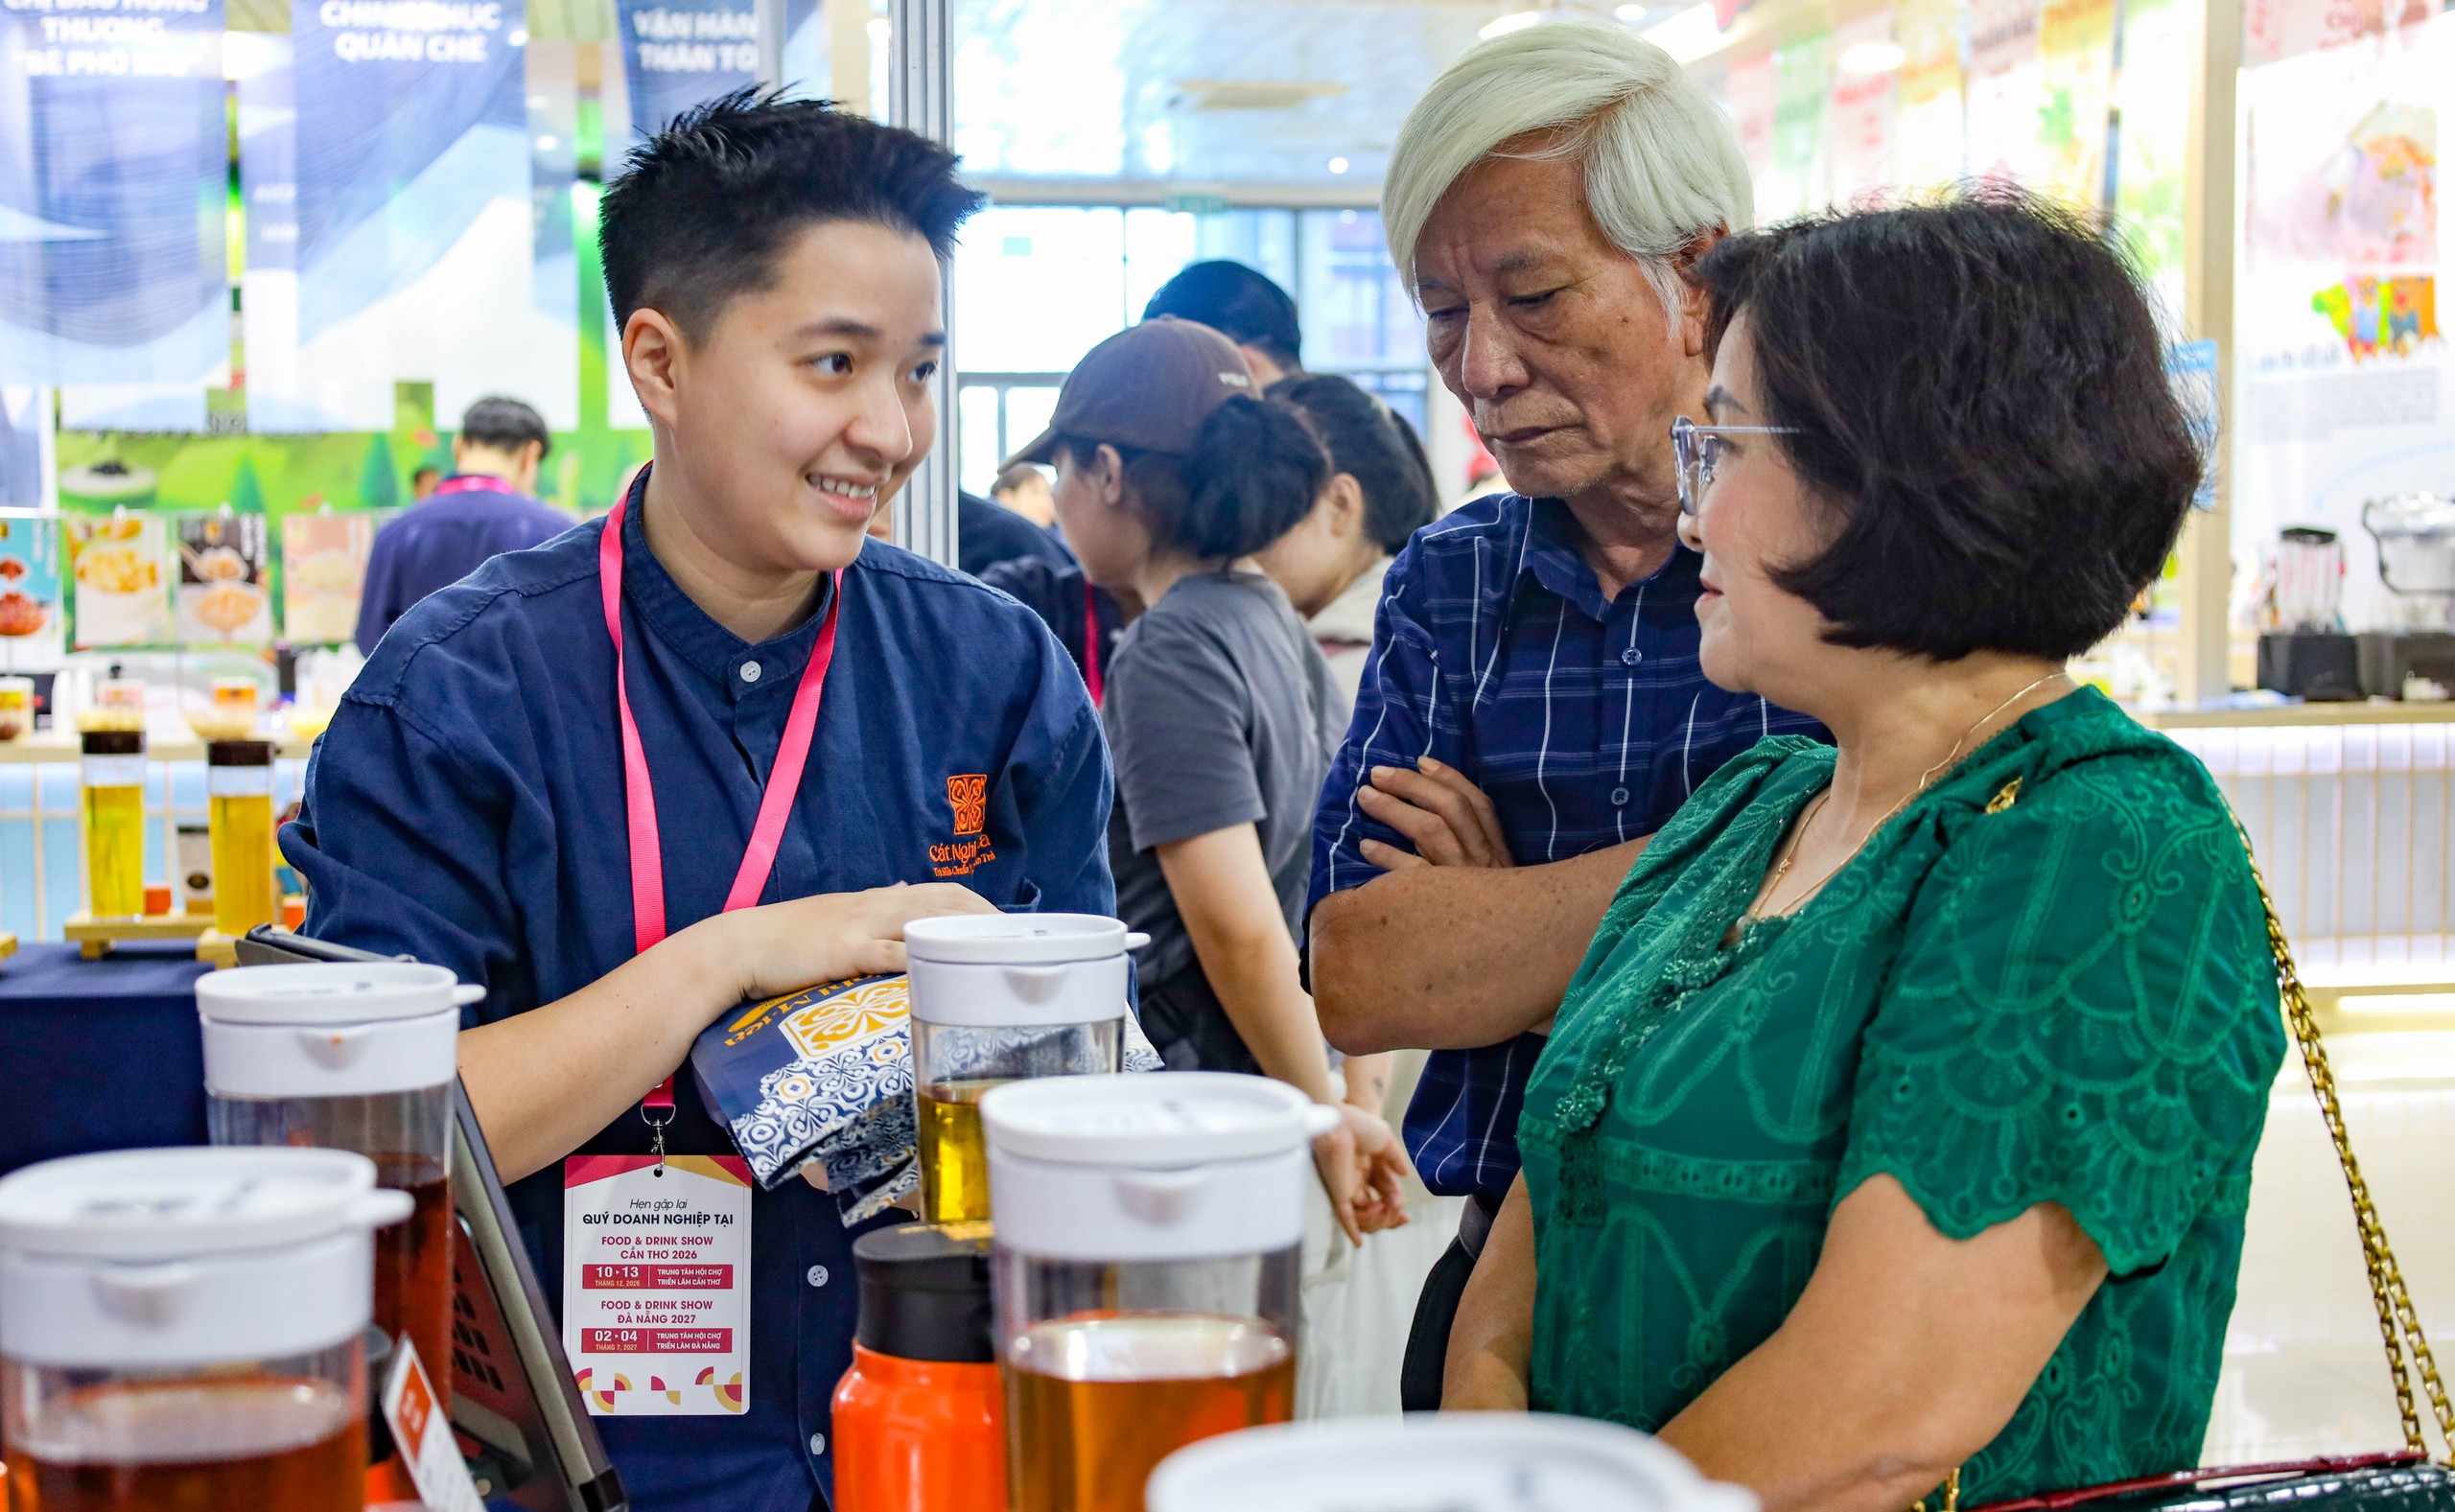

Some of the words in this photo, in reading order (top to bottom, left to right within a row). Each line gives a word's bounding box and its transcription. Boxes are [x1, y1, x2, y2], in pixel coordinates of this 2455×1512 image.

[929, 843, 953, 862] Cát
[629, 1198, 651, 1210] Hẹn
[653, 1198, 674, 1212] gặp
[675, 1198, 689, 1210] lại
[582, 1211, 609, 1225] QUÝ
[613, 1214, 660, 1224] DOANH
[664, 1211, 711, 1228] NGHIỆP
[713, 1214, 734, 1228] TẠI
[601, 1236, 632, 1245] FOOD
[635, 1236, 643, 1245] &
[645, 1236, 678, 1245] DRINK
[681, 1236, 713, 1245] SHOW
[620, 1245, 644, 1259] CẦN
[647, 1249, 669, 1259] THƠ
[672, 1249, 698, 1259] 2026
[596, 1267, 613, 1278] 10
[621, 1267, 640, 1278] 13
[681, 1268, 694, 1276] TÂM
[695, 1268, 708, 1277] HỘI
[708, 1268, 723, 1277] CHỢ
[595, 1278, 616, 1287] THÁNG
[657, 1277, 677, 1286] TRIỂN
[677, 1277, 691, 1286] LÃM
[691, 1277, 707, 1286] CẦN
[600, 1300, 631, 1310] FOOD
[634, 1300, 643, 1310] &
[644, 1300, 677, 1310] DRINK
[680, 1300, 713, 1310] SHOW
[617, 1312, 633, 1324] ĐÀ
[636, 1310, 668, 1324] NẴNG
[671, 1314, 696, 1324] 2027
[595, 1330, 612, 1341] 02
[620, 1330, 638, 1341] 04
[679, 1331, 693, 1339] TÂM
[694, 1331, 707, 1340] HỘI
[707, 1332, 722, 1340] CHỢ
[596, 1342, 616, 1351] THÁNG
[691, 1340, 702, 1349] ĐÀ
[702, 1340, 721, 1349] NẴNG
